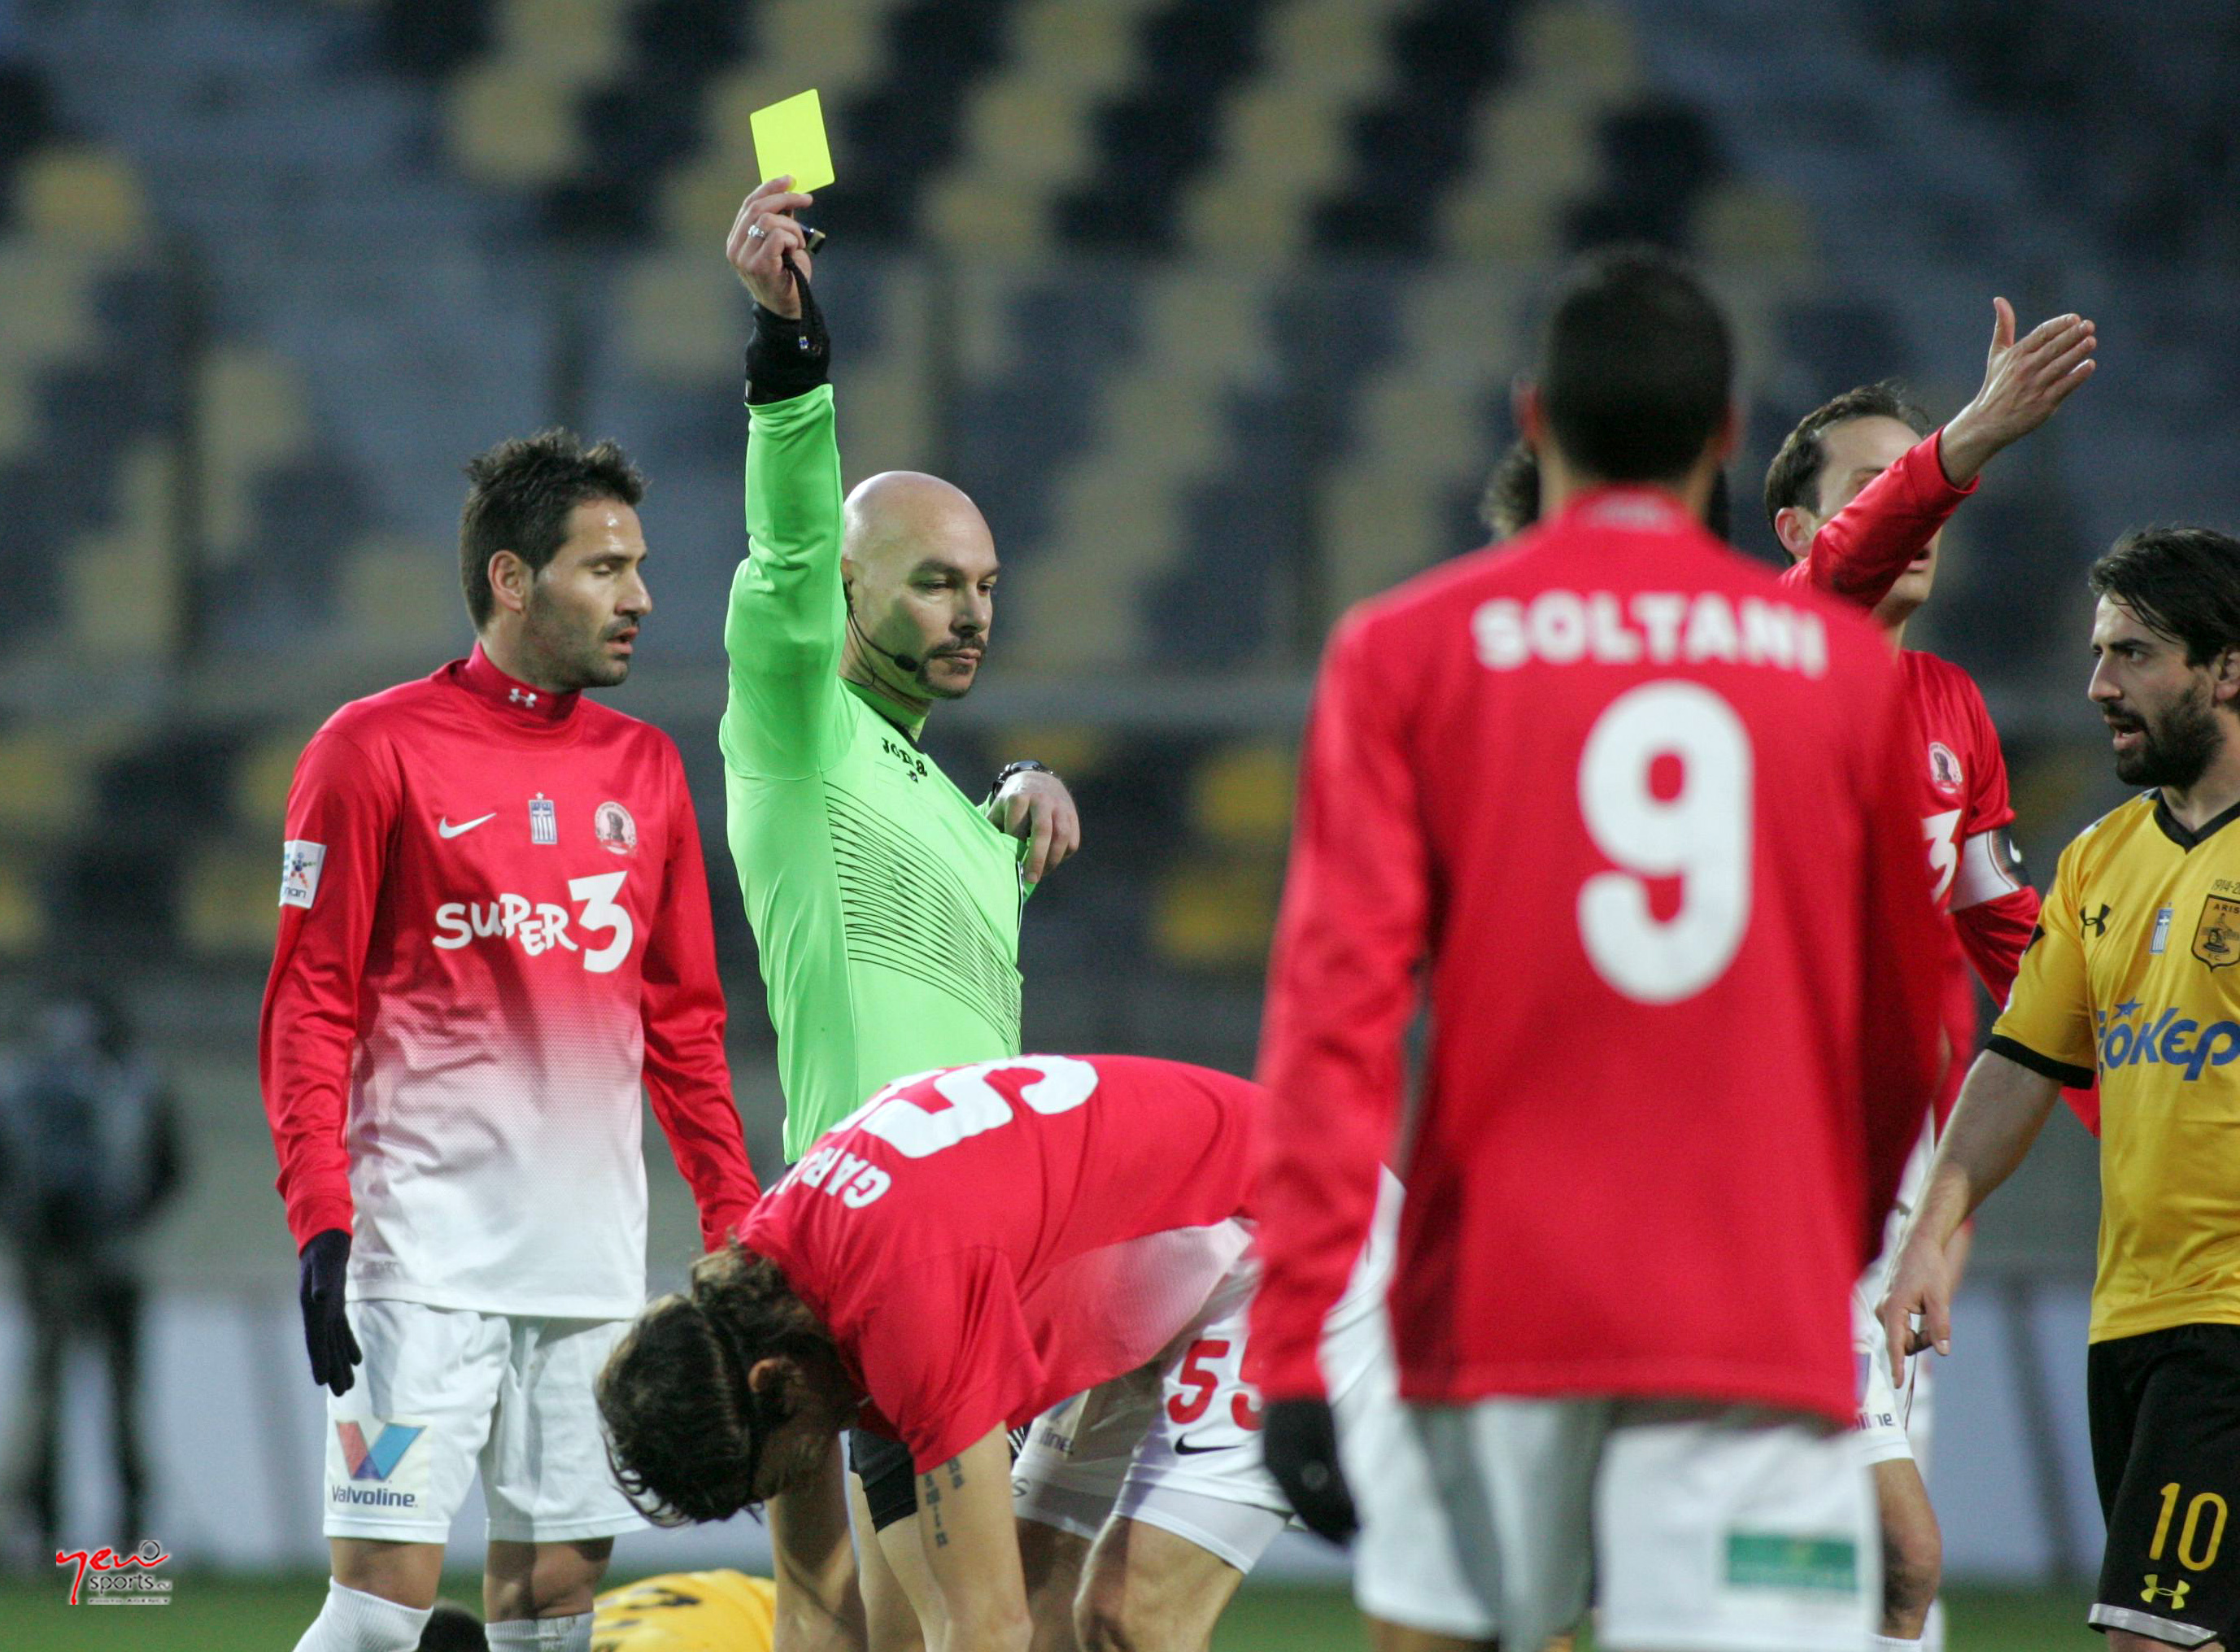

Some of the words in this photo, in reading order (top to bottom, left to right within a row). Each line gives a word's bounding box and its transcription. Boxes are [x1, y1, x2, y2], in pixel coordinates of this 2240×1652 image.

[1470, 589, 1827, 679] SOLTANI
[1576, 678, 1754, 1005] 9
[432, 894, 578, 956] SUPER
[568, 870, 634, 974] 3
[332, 1484, 416, 1507] Valvoline
[2149, 1483, 2228, 1571] 10
